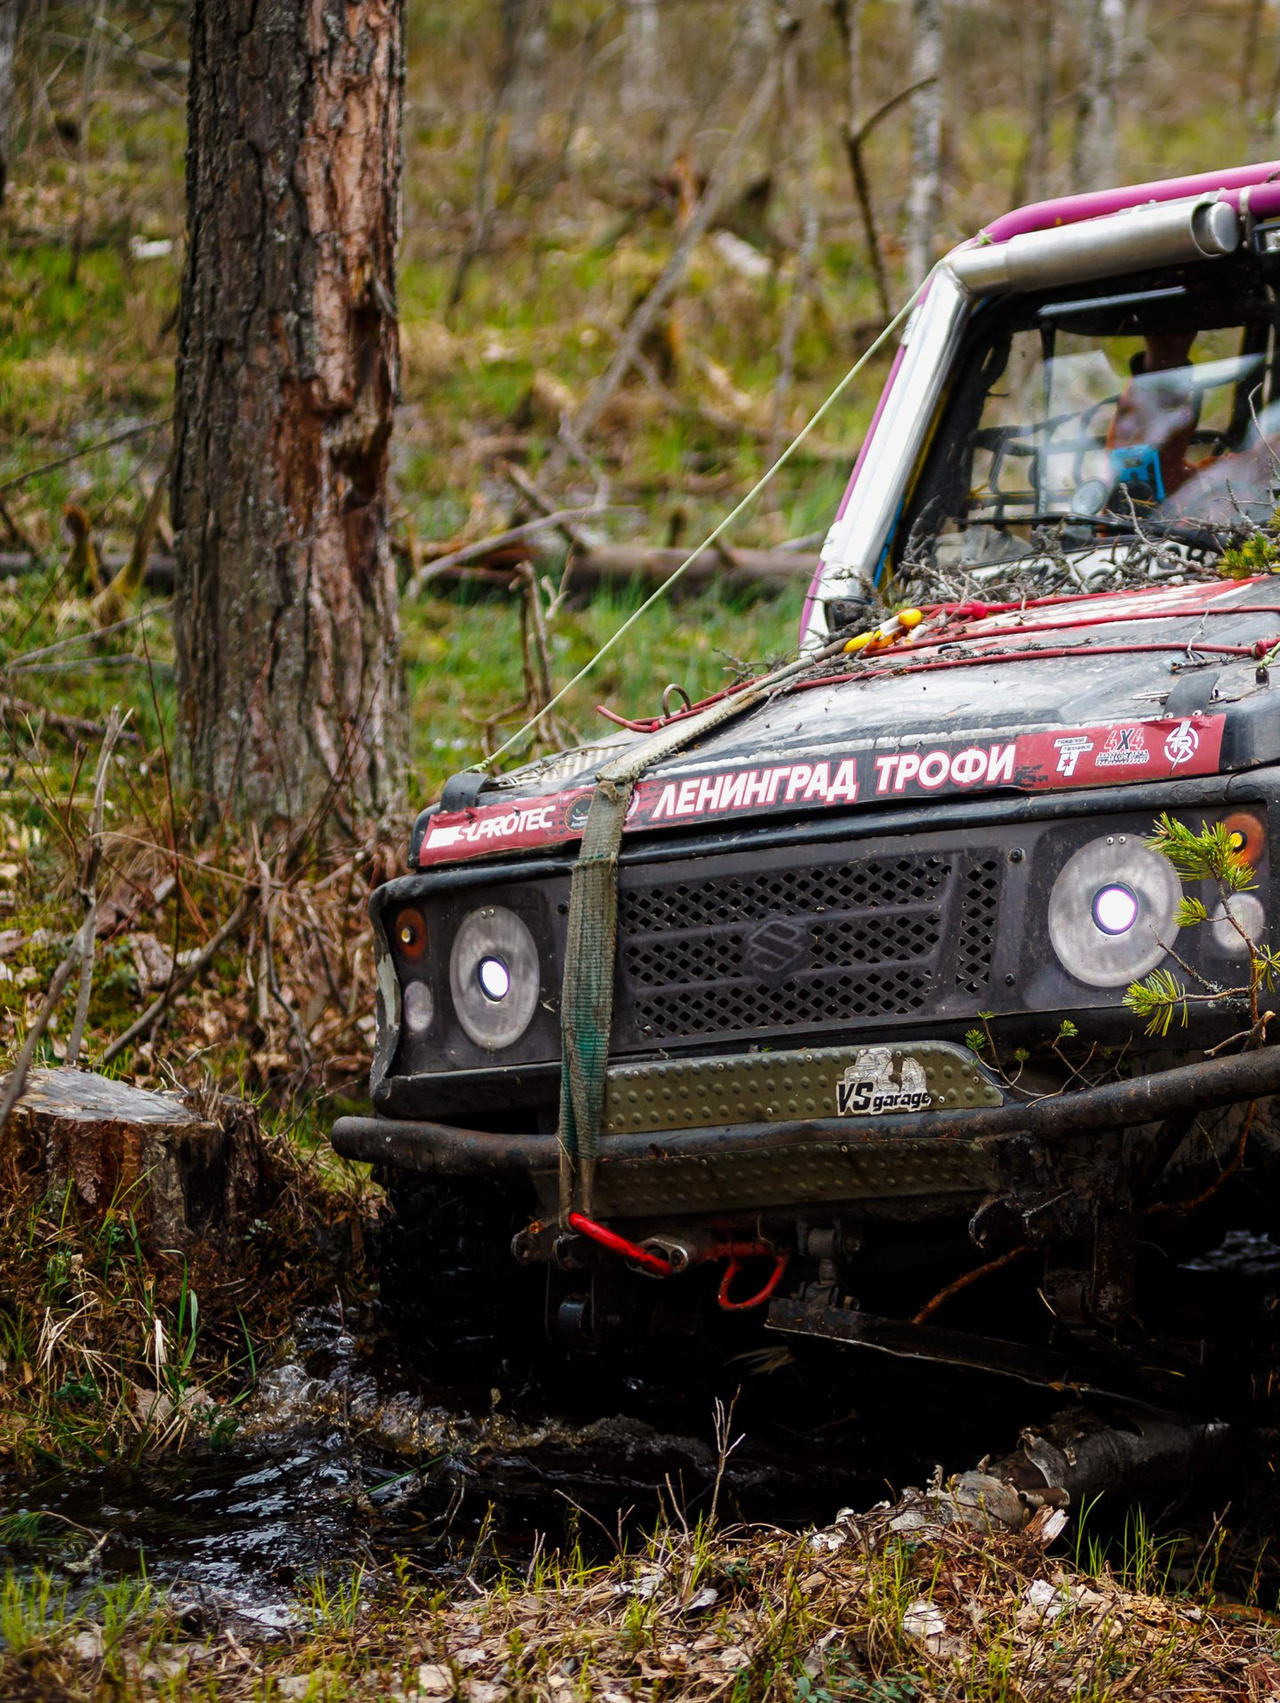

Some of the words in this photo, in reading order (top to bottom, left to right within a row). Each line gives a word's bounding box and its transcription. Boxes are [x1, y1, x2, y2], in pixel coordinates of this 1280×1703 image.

[651, 760, 858, 818] ЛЕНИНГРАД
[875, 744, 1017, 792] ТРОФИ
[456, 805, 556, 843] SUPROTEC
[838, 1081, 874, 1115] VS
[872, 1090, 932, 1113] garage
